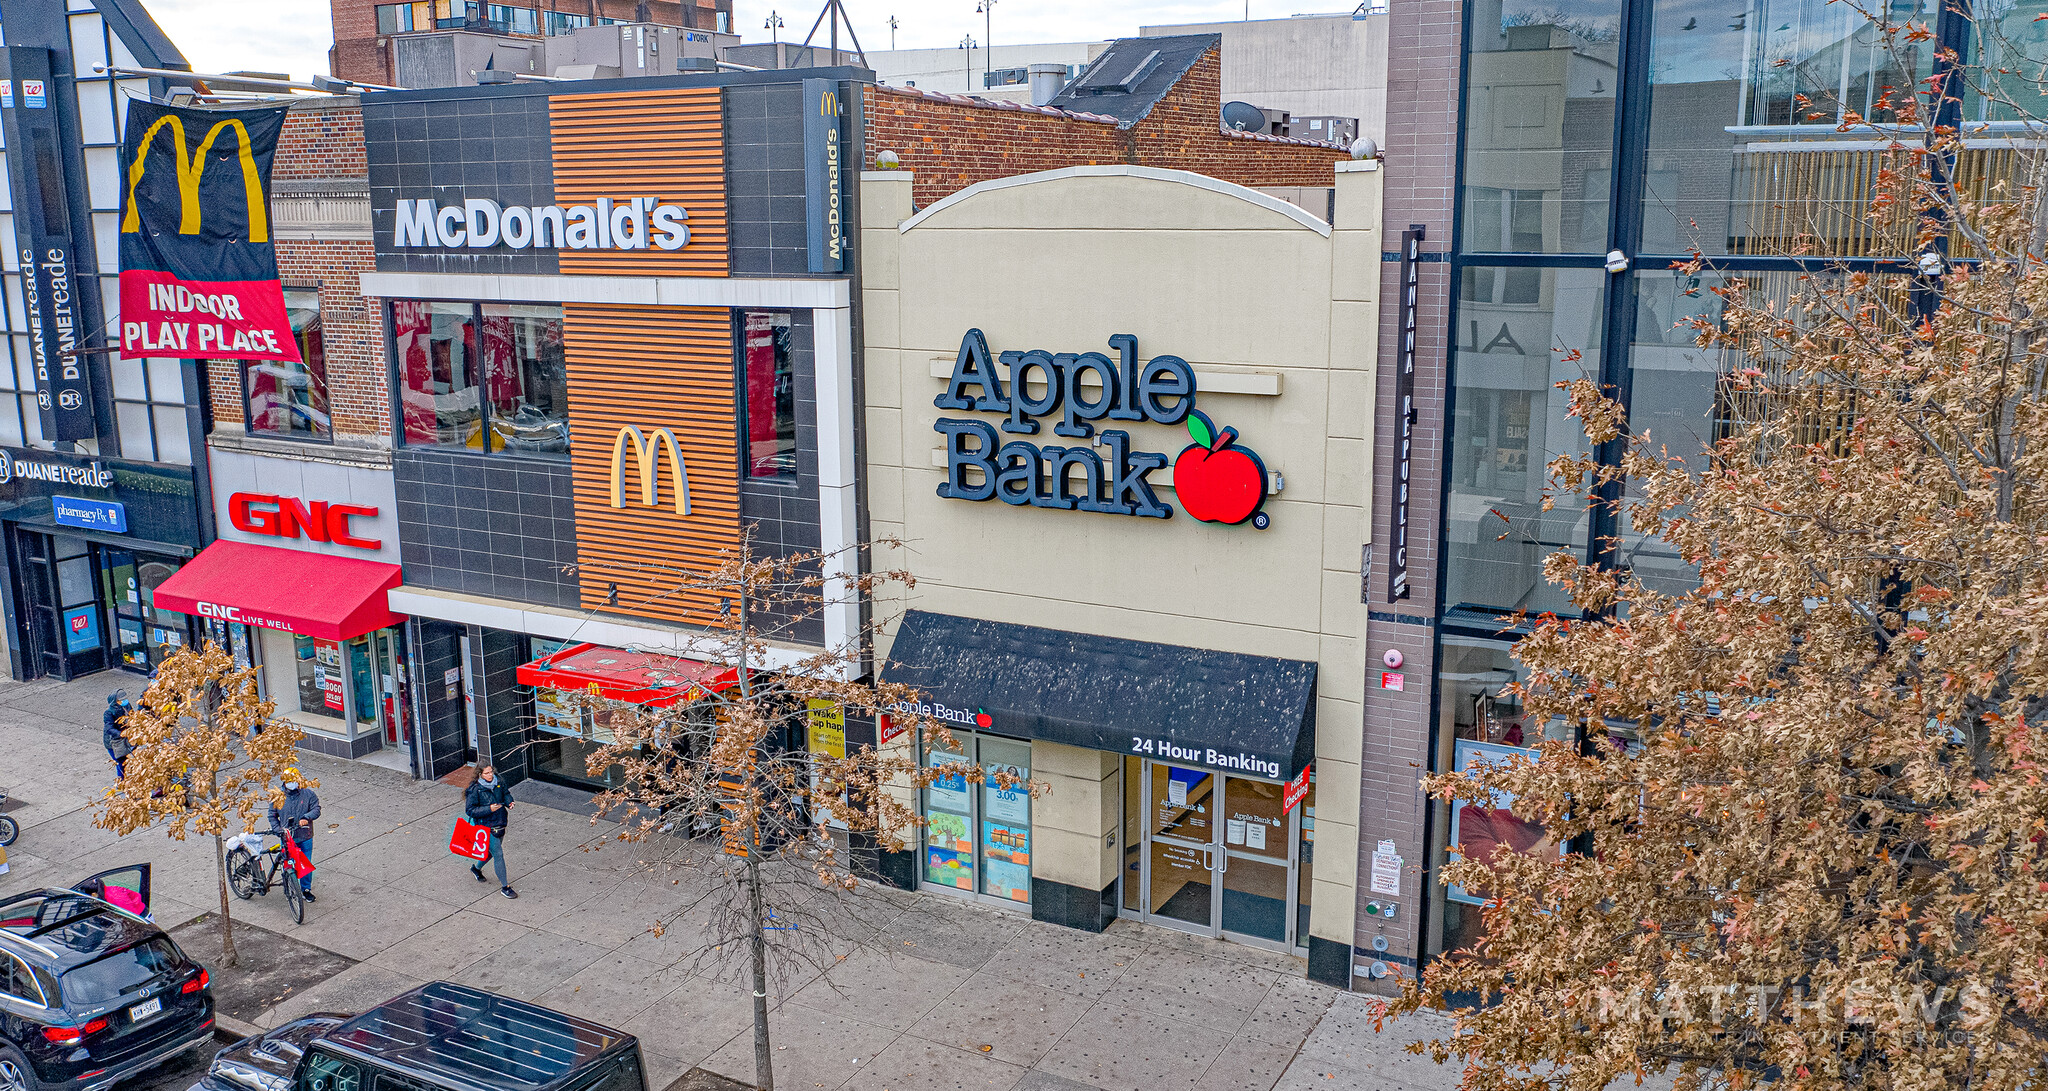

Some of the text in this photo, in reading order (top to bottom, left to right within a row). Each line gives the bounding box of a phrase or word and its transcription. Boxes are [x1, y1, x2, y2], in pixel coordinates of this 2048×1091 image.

[692, 33, 709, 44] YORK
[827, 128, 840, 260] McDonald's
[394, 197, 692, 251] McDonald's
[21, 249, 50, 381] DUANEreade
[42, 248, 80, 380] DUANEreade
[149, 283, 244, 321] INDOOR
[124, 321, 283, 354] PLAY PLACE
[933, 328, 1196, 439] Apple
[1397, 239, 1418, 568] BANANA REPUBLIC
[14, 461, 110, 489] DUANEreade
[933, 417, 1173, 520] Bank
[57, 503, 96, 523] pharmacy
[229, 491, 382, 550] GNC
[197, 601, 294, 631] GNC LIVE WELL
[536, 649, 547, 657] Get
[325, 681, 342, 694] BOGO
[813, 708, 837, 720] Wake
[933, 702, 977, 725] Bank
[1132, 737, 1280, 778] 24 Hour Banking
[1284, 782, 1309, 809] Checking
[1233, 812, 1272, 825] Apple Bank
